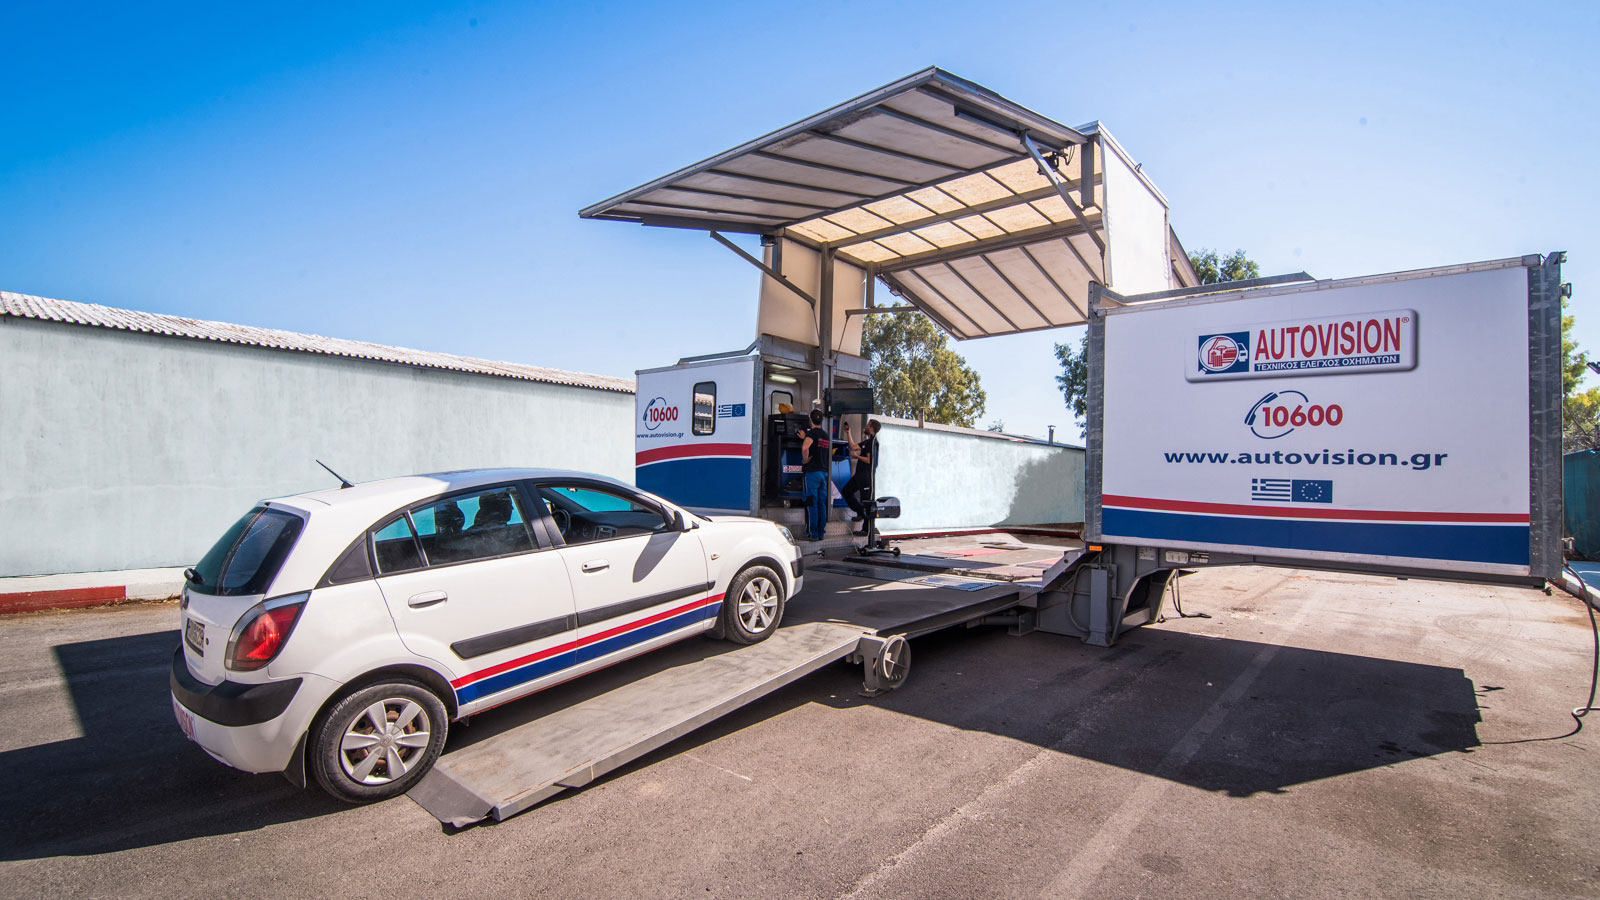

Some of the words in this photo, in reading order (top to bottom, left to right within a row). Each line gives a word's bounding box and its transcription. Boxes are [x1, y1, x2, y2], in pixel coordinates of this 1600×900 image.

[1256, 362, 1299, 371] ΤΕΧΝΙΚΟΣ
[1300, 359, 1340, 368] ΕΛΕΓΧΟΣ
[1342, 355, 1397, 366] ΟΧΗΜΑΤΩΝ
[649, 406, 678, 422] 10600
[1262, 404, 1343, 427] 10600
[1164, 449, 1448, 470] www.autovision.gr
